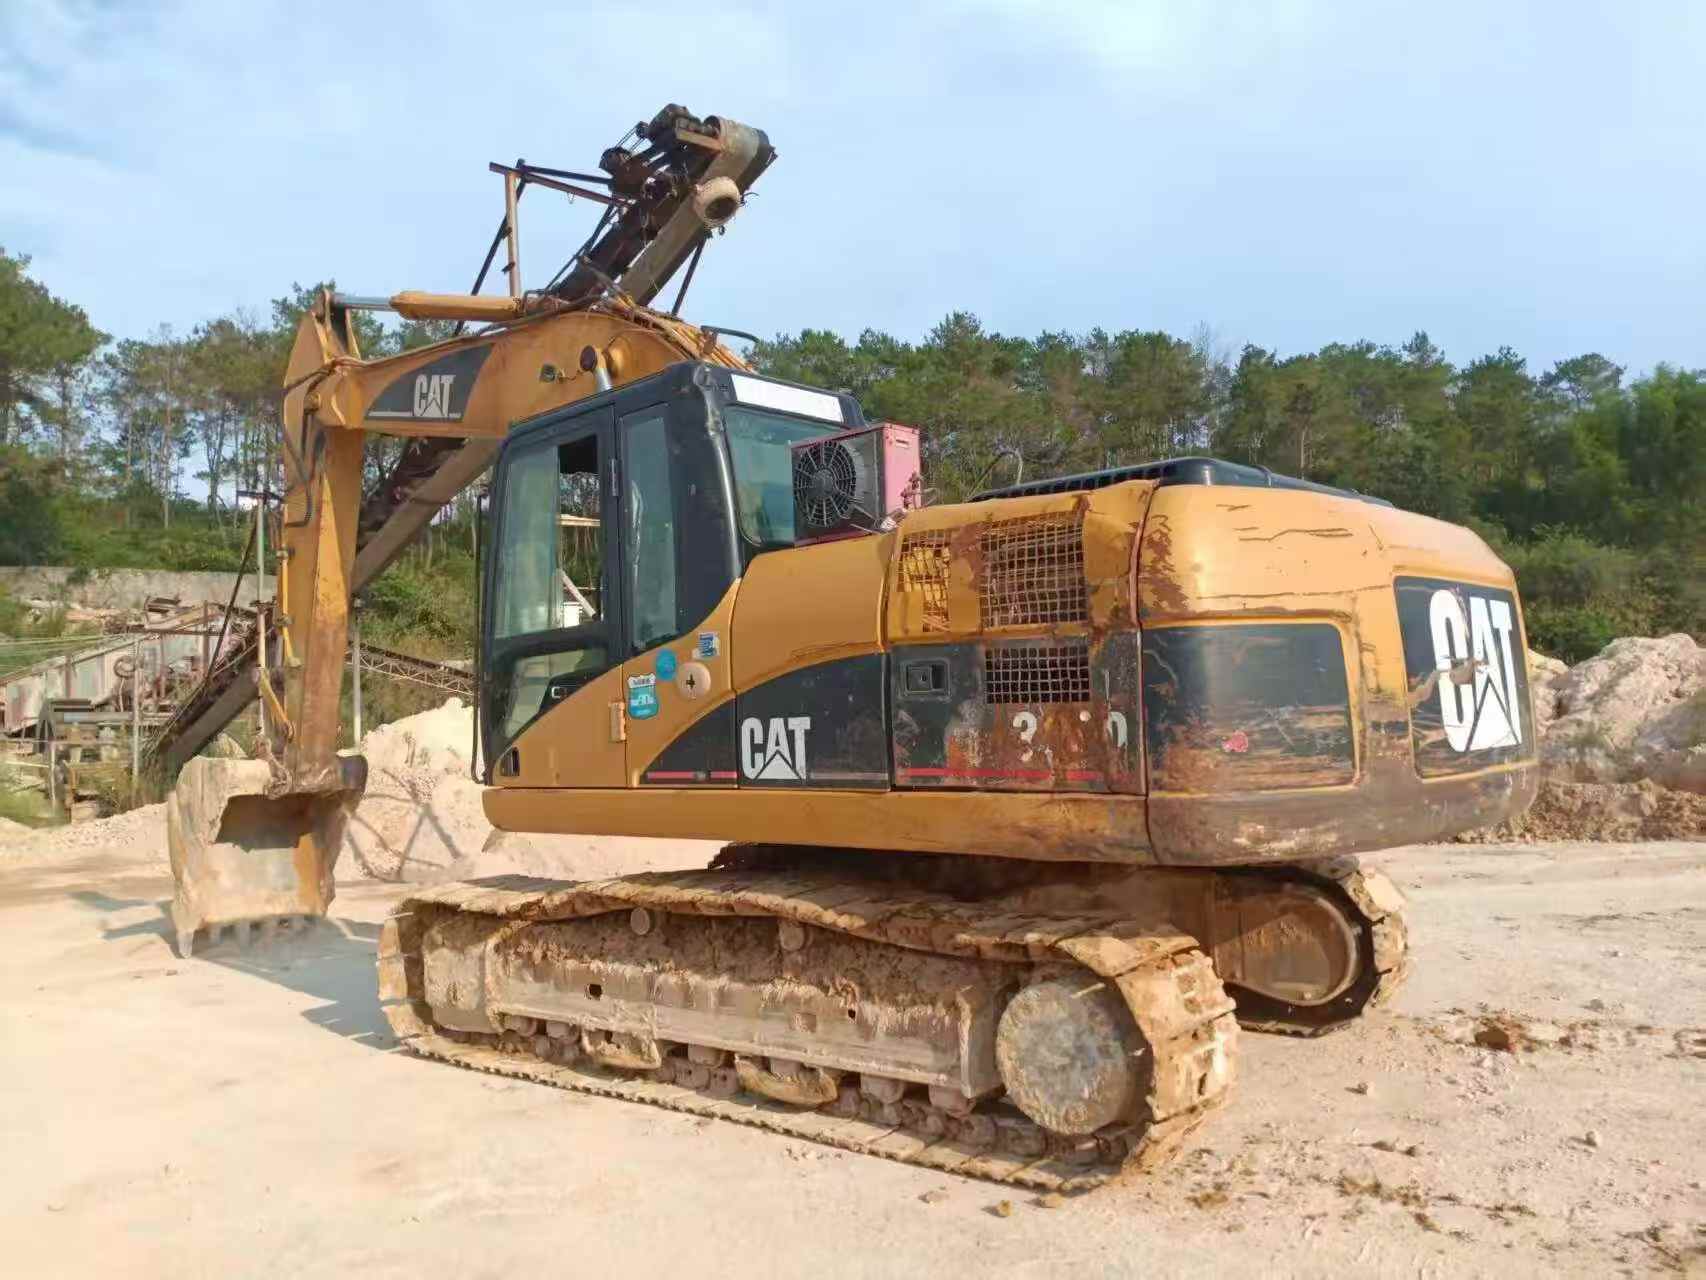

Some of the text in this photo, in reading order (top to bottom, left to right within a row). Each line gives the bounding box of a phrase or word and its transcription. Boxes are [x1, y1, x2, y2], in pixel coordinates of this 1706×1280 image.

[414, 374, 456, 418] CAT
[1429, 589, 1522, 752] CAT
[741, 716, 811, 780] CAT
